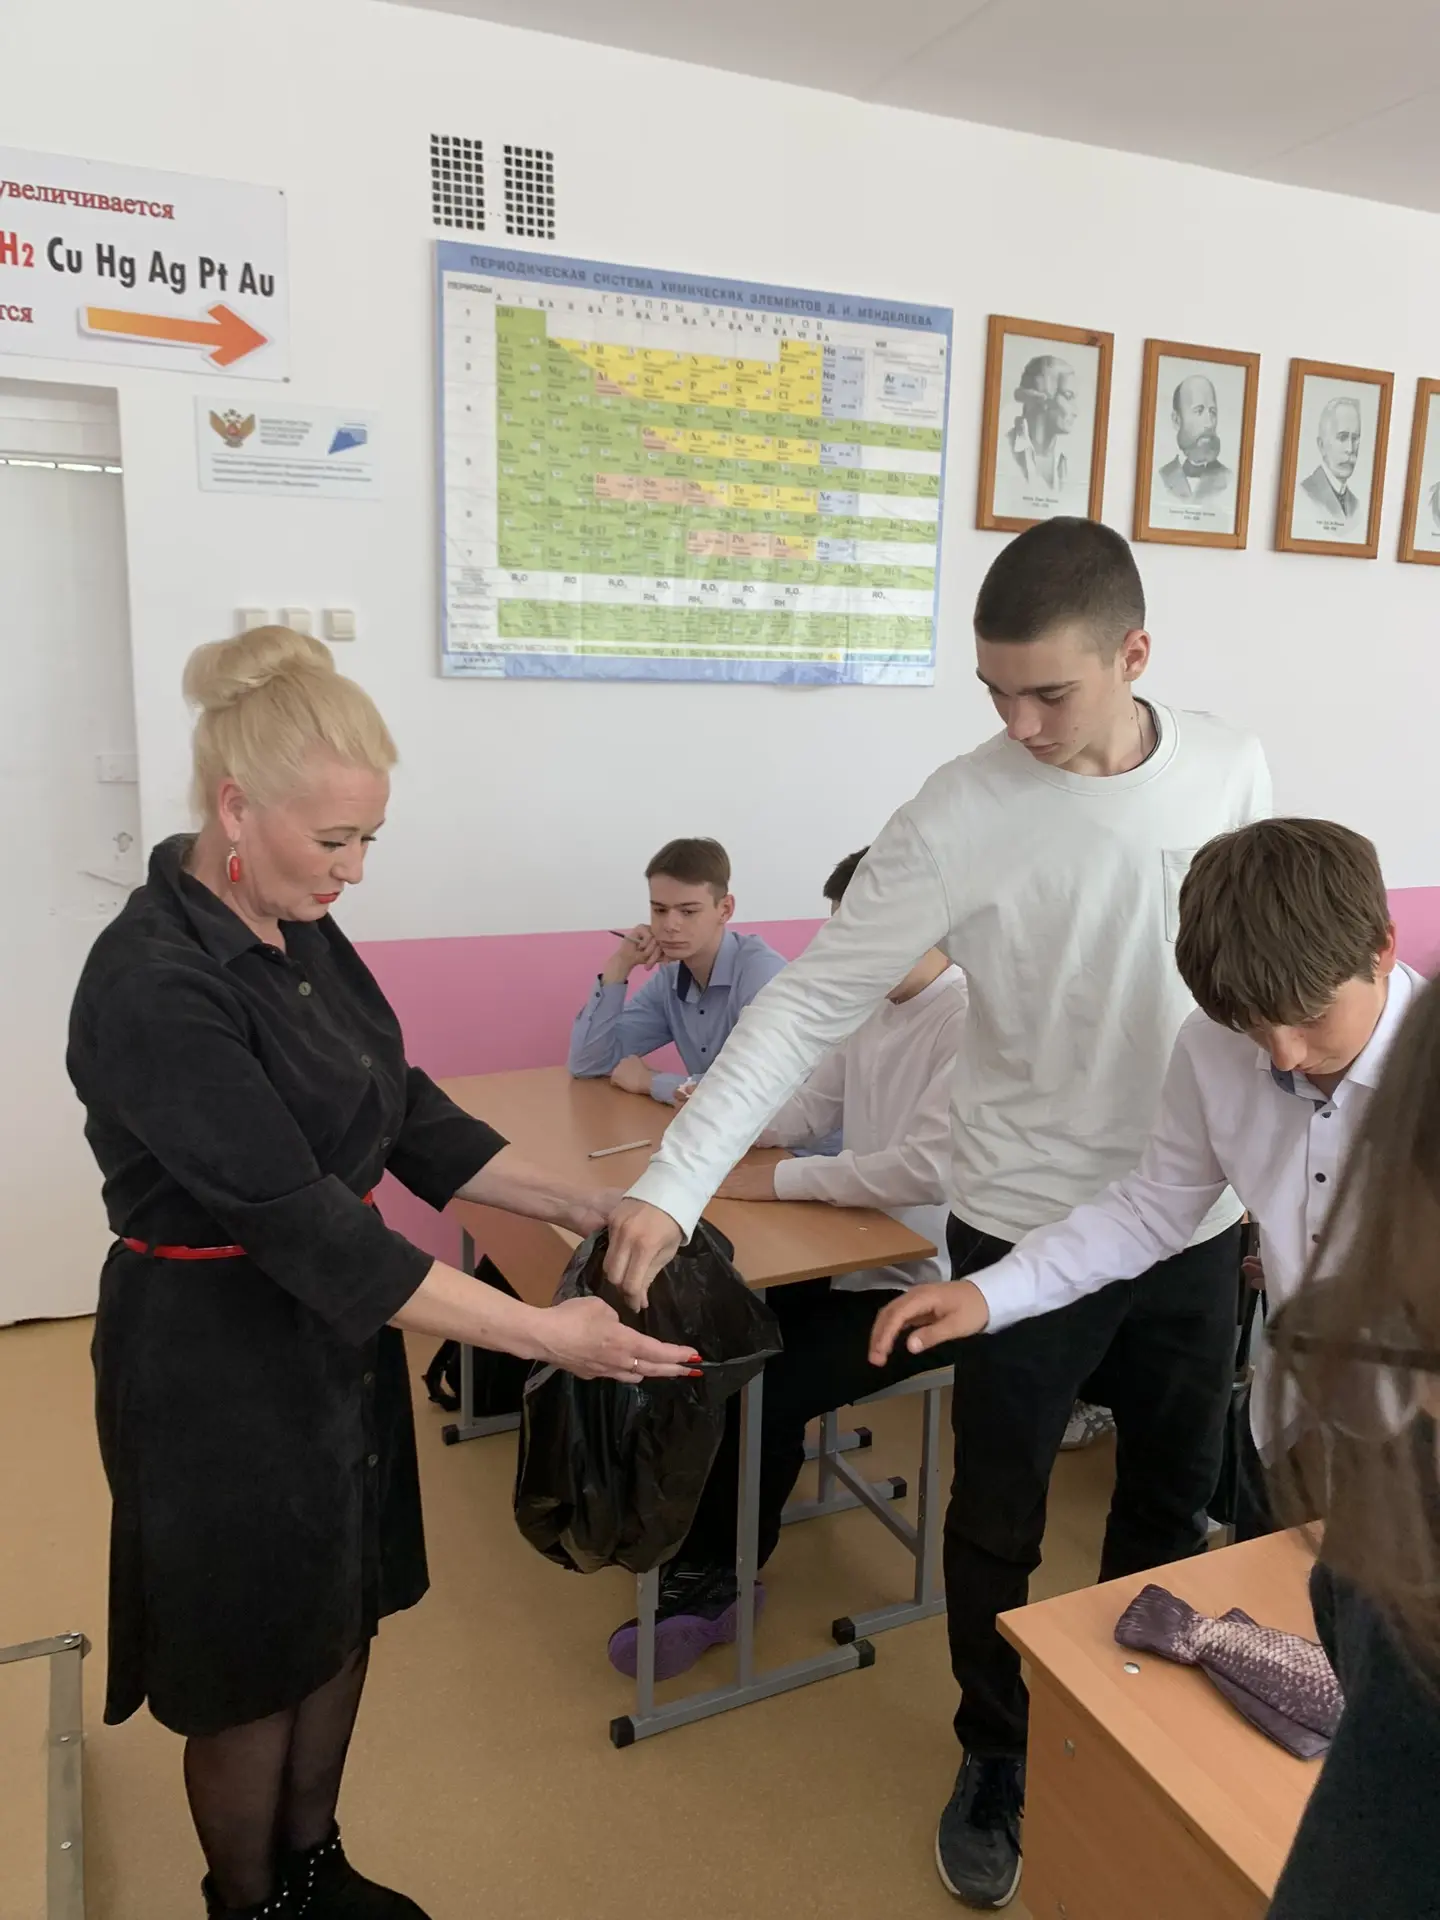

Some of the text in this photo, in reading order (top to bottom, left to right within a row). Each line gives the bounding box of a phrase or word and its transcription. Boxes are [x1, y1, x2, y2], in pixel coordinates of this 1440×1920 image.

[47, 236, 82, 274] Cu
[96, 243, 136, 289] Hg
[148, 250, 186, 294] Ag
[199, 256, 228, 292] Pt
[238, 262, 275, 297] Au
[470, 254, 586, 281] ПЕРИОДИЧЕСКАЯ
[593, 272, 654, 291] СИСТЕМА
[660, 280, 744, 303] ХИМИЧЕСКИХ
[750, 294, 822, 313] ЭЛЕМЕНТОВ
[858, 308, 933, 326] МЕНДЕЛЕЕВА
[823, 345, 836, 357] He
[822, 371, 836, 382] Ne
[885, 373, 896, 384] Ar
[822, 394, 832, 405] Ar
[820, 442, 832, 453] Kr
